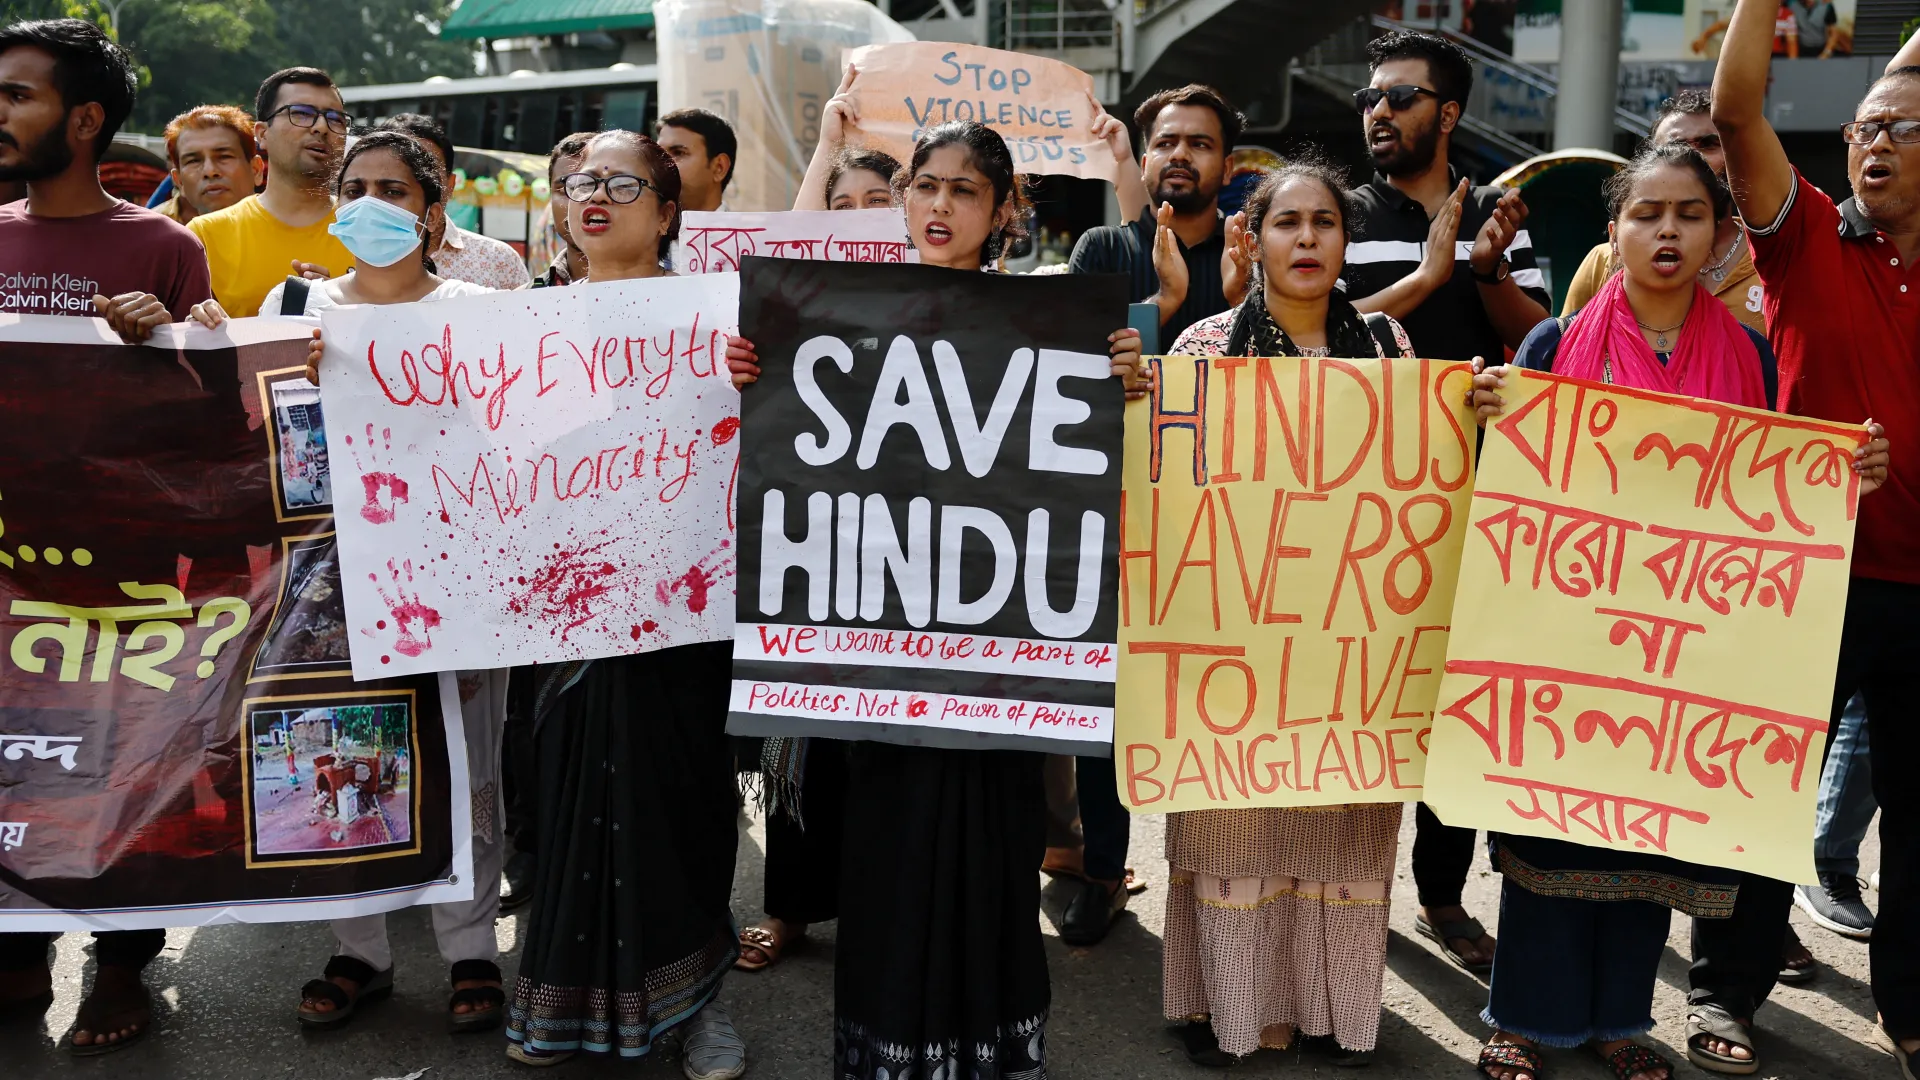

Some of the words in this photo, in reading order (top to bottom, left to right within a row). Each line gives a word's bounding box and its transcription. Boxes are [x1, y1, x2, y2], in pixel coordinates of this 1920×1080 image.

[904, 97, 1072, 128] VIOLENCE
[934, 51, 1031, 94] STOP
[51, 291, 96, 312] Klein
[52, 273, 98, 293] Klein
[368, 324, 522, 430] Why
[793, 334, 1111, 478] SAVE
[1149, 358, 1474, 492] HINDUS
[432, 428, 698, 524] Minority
[1496, 370, 1869, 537] বাংলাদেশ
[759, 488, 1105, 639] HINDU
[1119, 487, 1329, 630] HAVE
[1322, 491, 1452, 631] R8
[1474, 490, 1643, 598] কারো
[1642, 524, 1845, 617] বাপের
[10, 581, 251, 692] নাই?
[757, 625, 817, 657] We
[825, 630, 895, 654] want
[901, 632, 934, 657] to
[939, 636, 975, 659] be
[982, 639, 1003, 658] a
[1084, 645, 1112, 668] of
[1128, 641, 1257, 739] TO
[1277, 626, 1446, 729] LIVE
[1595, 607, 1706, 678] না
[856, 692, 899, 717] Not
[908, 697, 929, 718] a
[1007, 702, 1027, 726] of
[1440, 660, 1829, 798] বাংলাদেশ
[1126, 727, 1432, 806] BANGLADES
